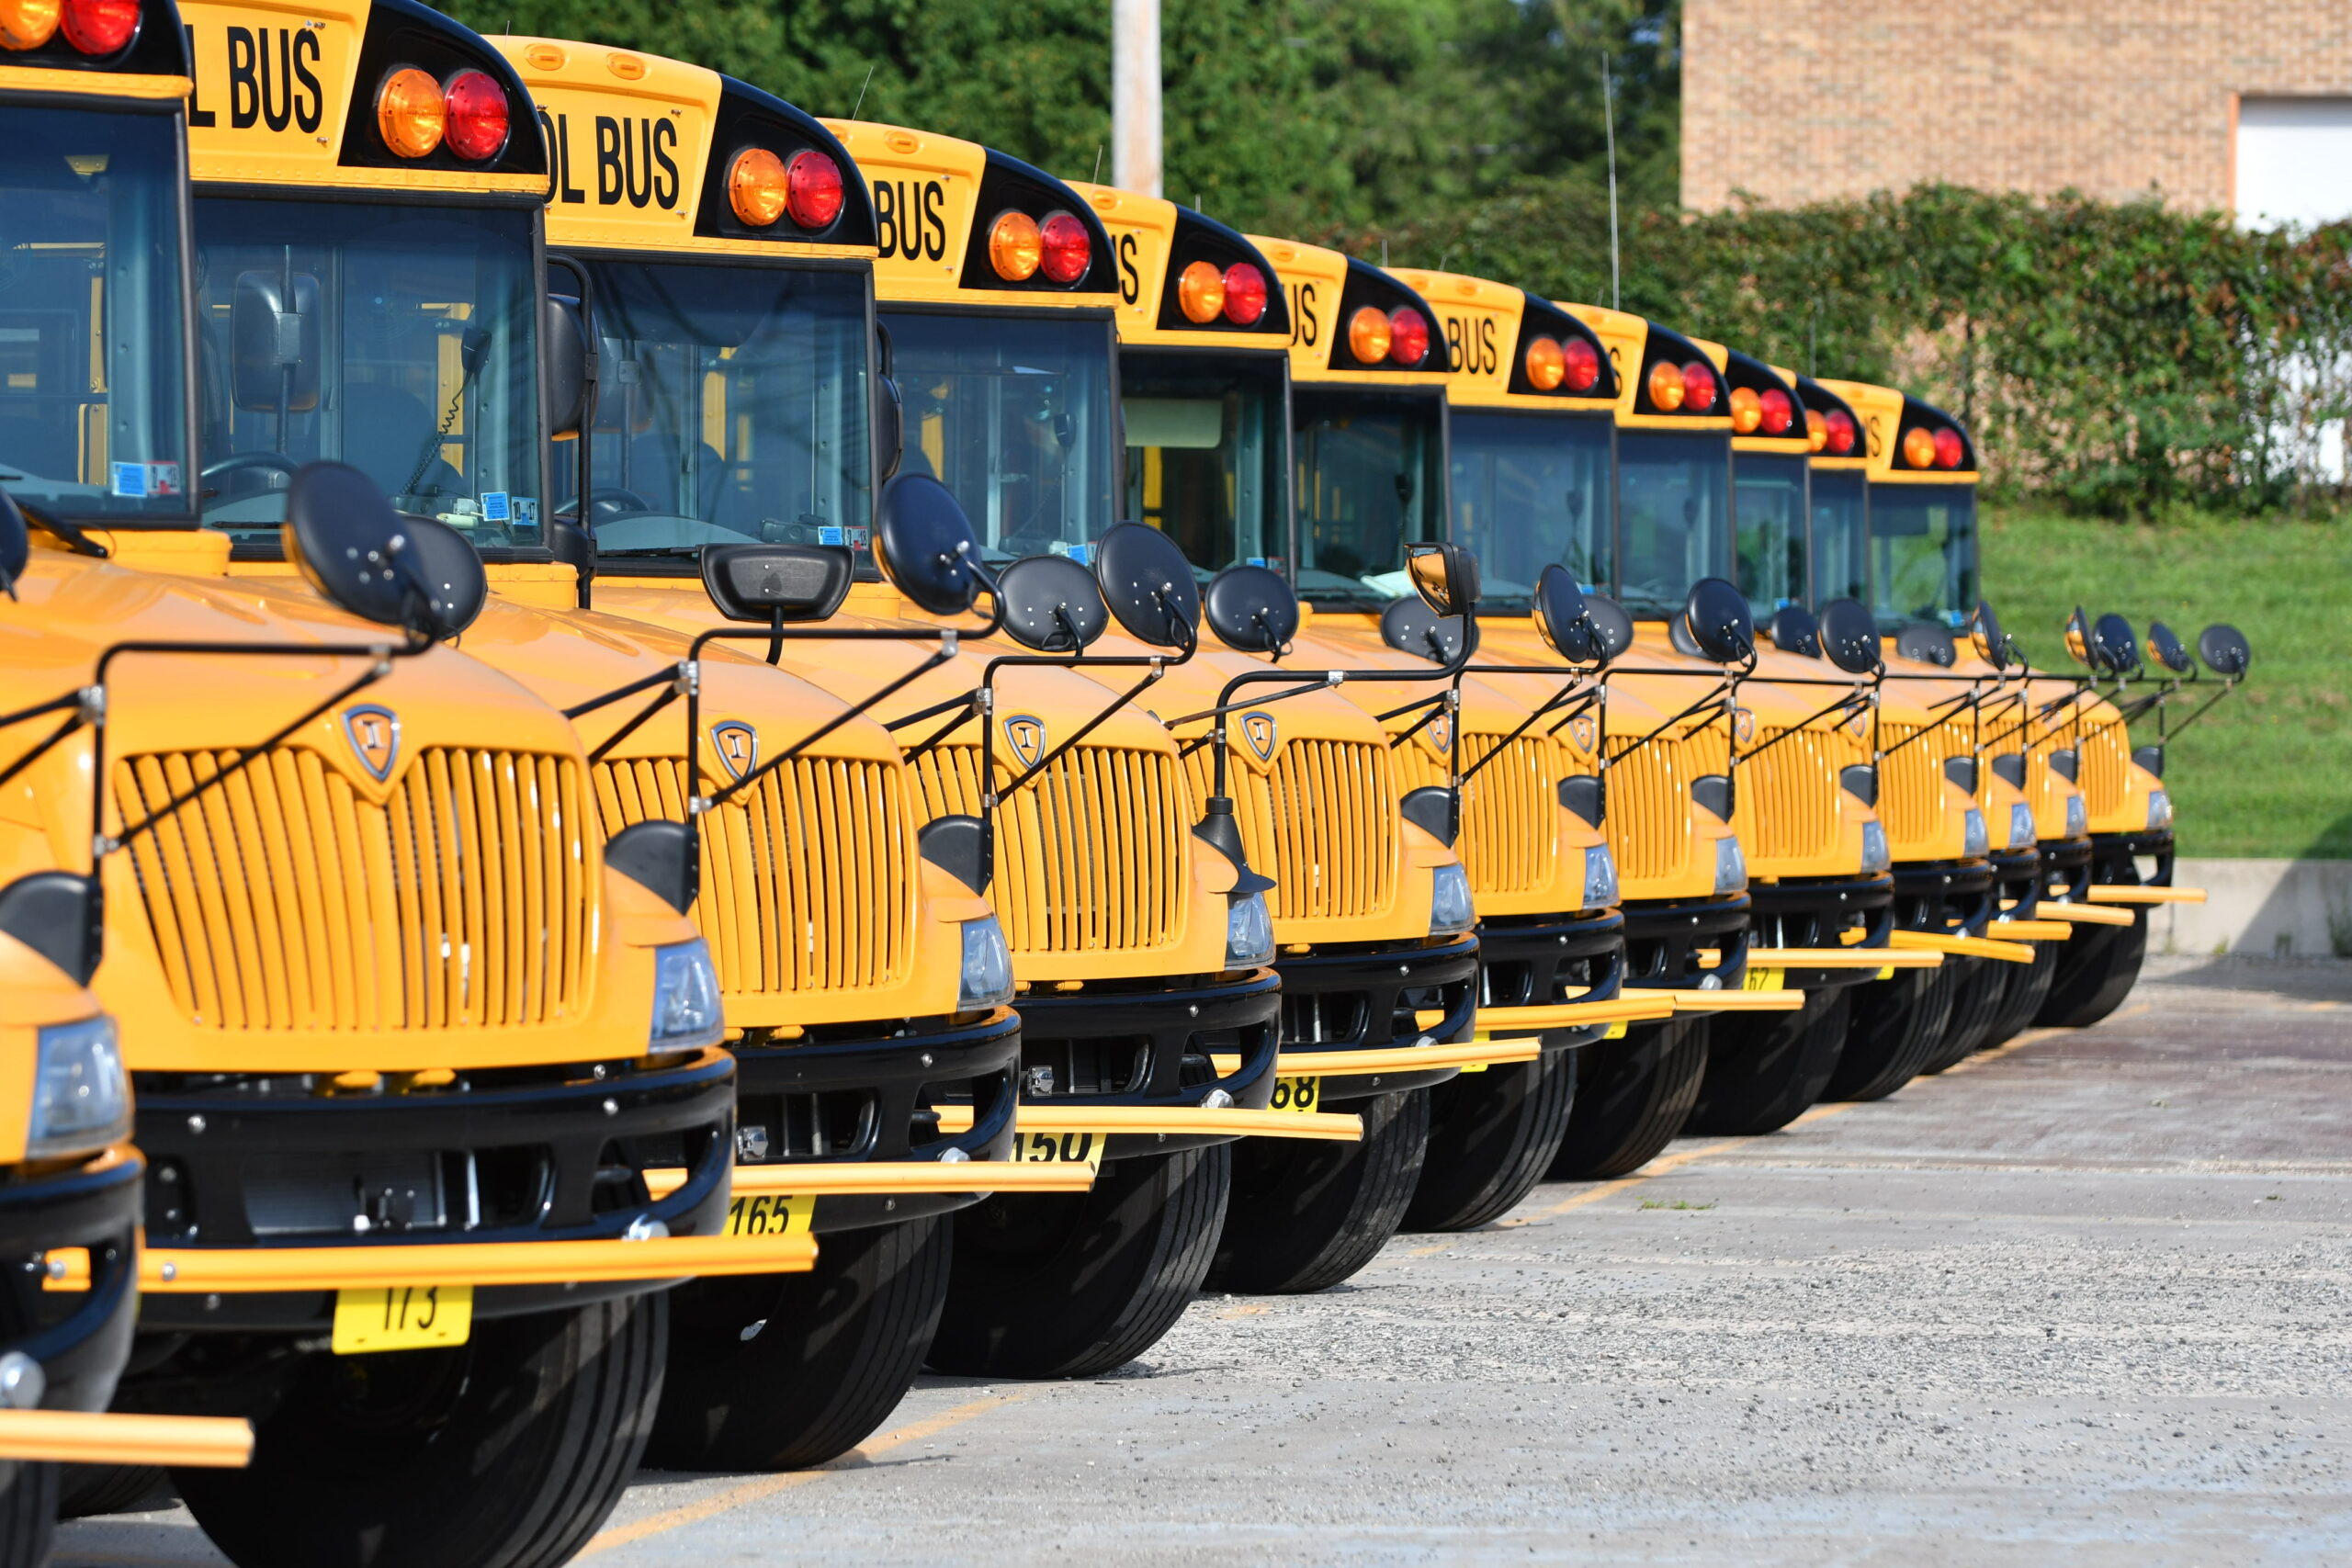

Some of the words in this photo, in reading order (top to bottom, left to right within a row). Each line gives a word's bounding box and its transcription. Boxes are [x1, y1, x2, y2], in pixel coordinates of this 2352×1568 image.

[227, 26, 323, 133] BUS
[595, 116, 679, 209] BUS
[874, 180, 945, 262] BUS
[1448, 318, 1497, 375] BUS
[729, 1195, 793, 1235] 165
